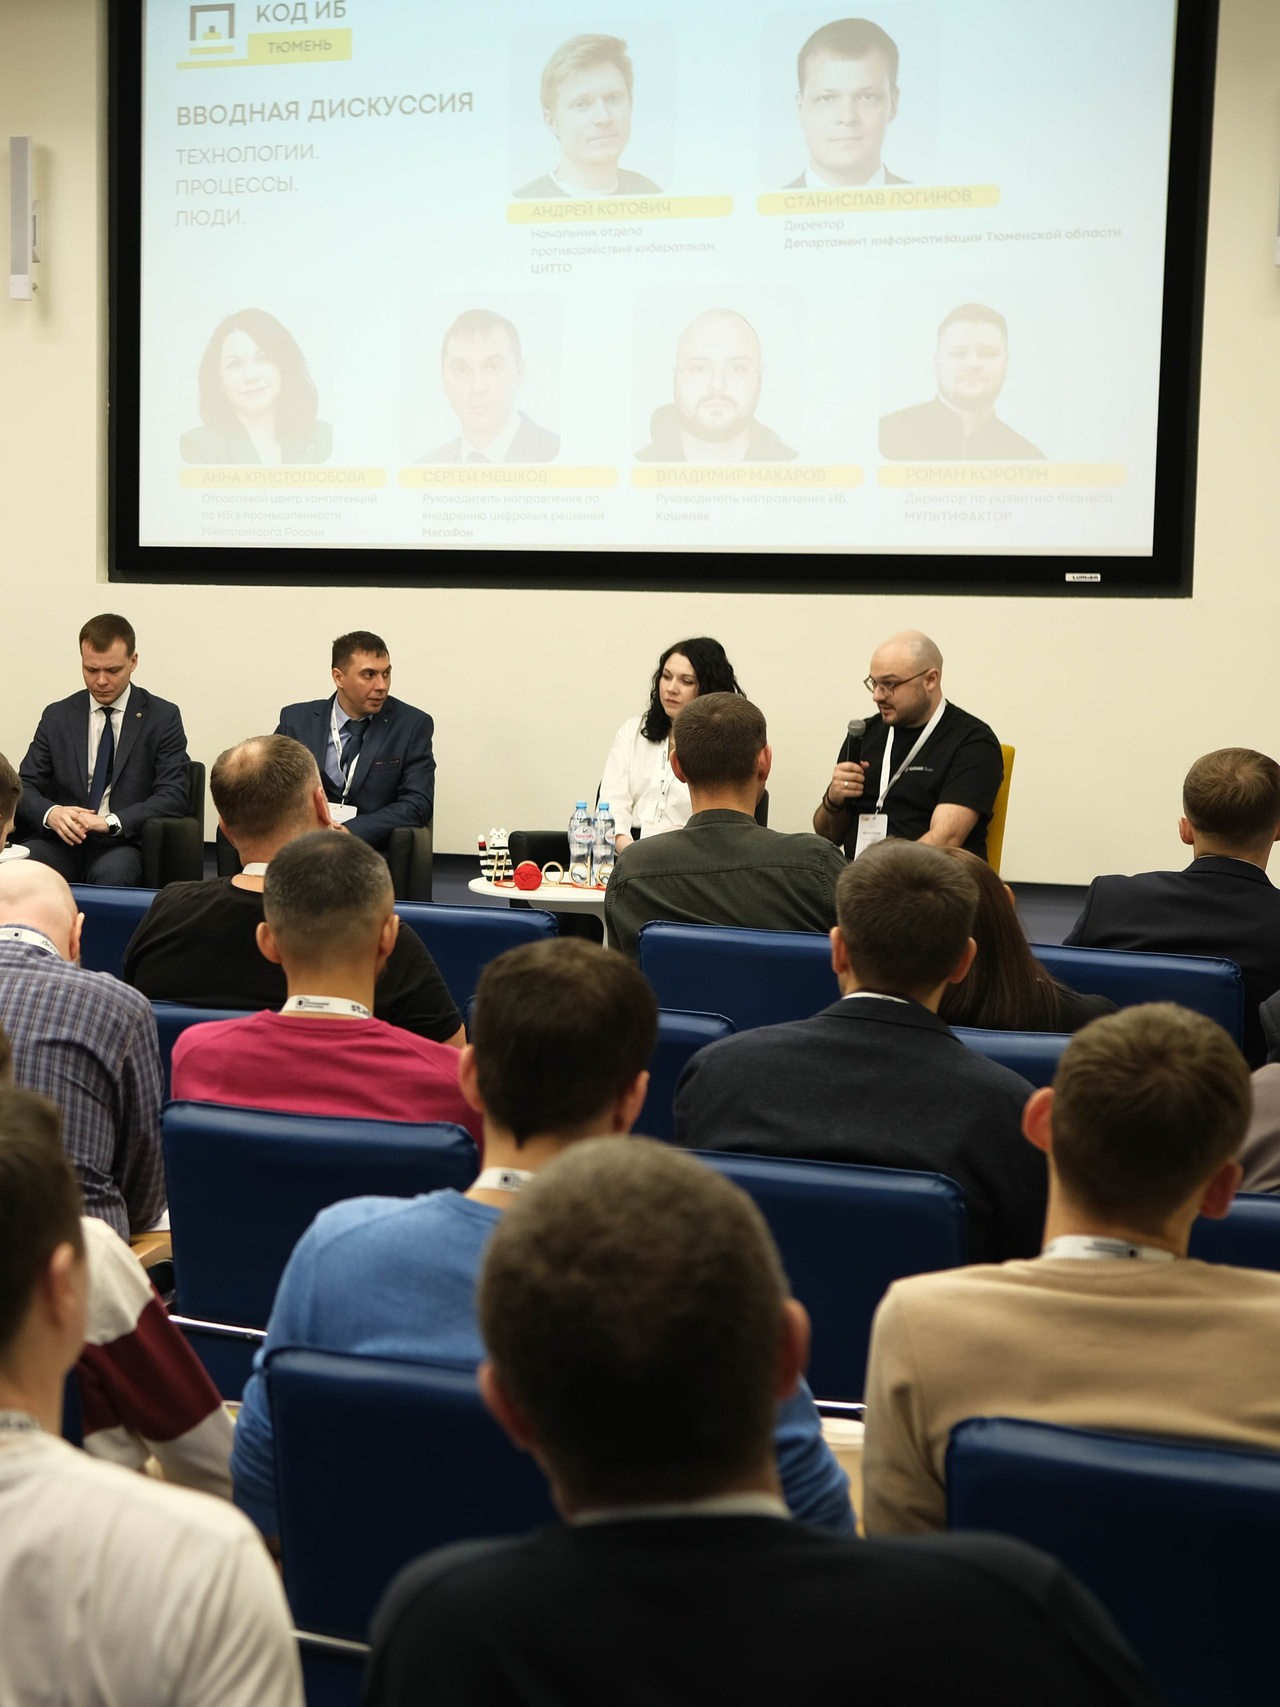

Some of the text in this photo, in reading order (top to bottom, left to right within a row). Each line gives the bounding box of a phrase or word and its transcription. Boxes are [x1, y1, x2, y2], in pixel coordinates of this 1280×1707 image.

[256, 0, 347, 25] КОД ИБ
[267, 38, 333, 54] ТЮМЕНЬ
[177, 92, 474, 127] ВВОДНАЯ ДИСКУССИЯ
[176, 143, 320, 166] ТЕХНОЛОГИИ.
[175, 175, 299, 198] ПРОЦЕССЫ.
[784, 189, 973, 209] СТАНИСЛАВ ЛОГИНОВ
[531, 201, 672, 218] АНДРЕЙ КОТОВИЧ
[174, 208, 246, 228] ЛЮДИ.
[784, 219, 845, 233] Директор
[531, 227, 644, 240] Начальник отдела
[783, 226, 1122, 251] Департамент информатизации Тюменской области
[531, 243, 633, 257] противодействия
[531, 263, 573, 274] ЦИТТО
[202, 470, 367, 484] АННА ХРИСТОЛЮБОВА
[423, 468, 548, 483] СЕРГЕЙ МЕШКОВ
[656, 469, 827, 483] ВЛАДИМИР МАКАРОВ
[905, 467, 1049, 481] РОМАН КОРОТУН
[201, 493, 378, 505] Отраслевой центр компетенций
[422, 493, 600, 505] Руководитель направления по
[656, 493, 740, 505] Руководитель
[742, 493, 826, 505] направления
[904, 492, 968, 504] Директор
[970, 494, 987, 504] по
[989, 494, 1055, 505] развитию
[201, 511, 215, 521] по
[217, 510, 233, 520] ИБ
[243, 511, 342, 522] промышленности
[422, 510, 605, 523] внедрению цифровых решений
[904, 510, 1013, 522] МУЛЬТИФАКТОР
[284, 526, 325, 537] России
[422, 527, 474, 538] МегаФон
